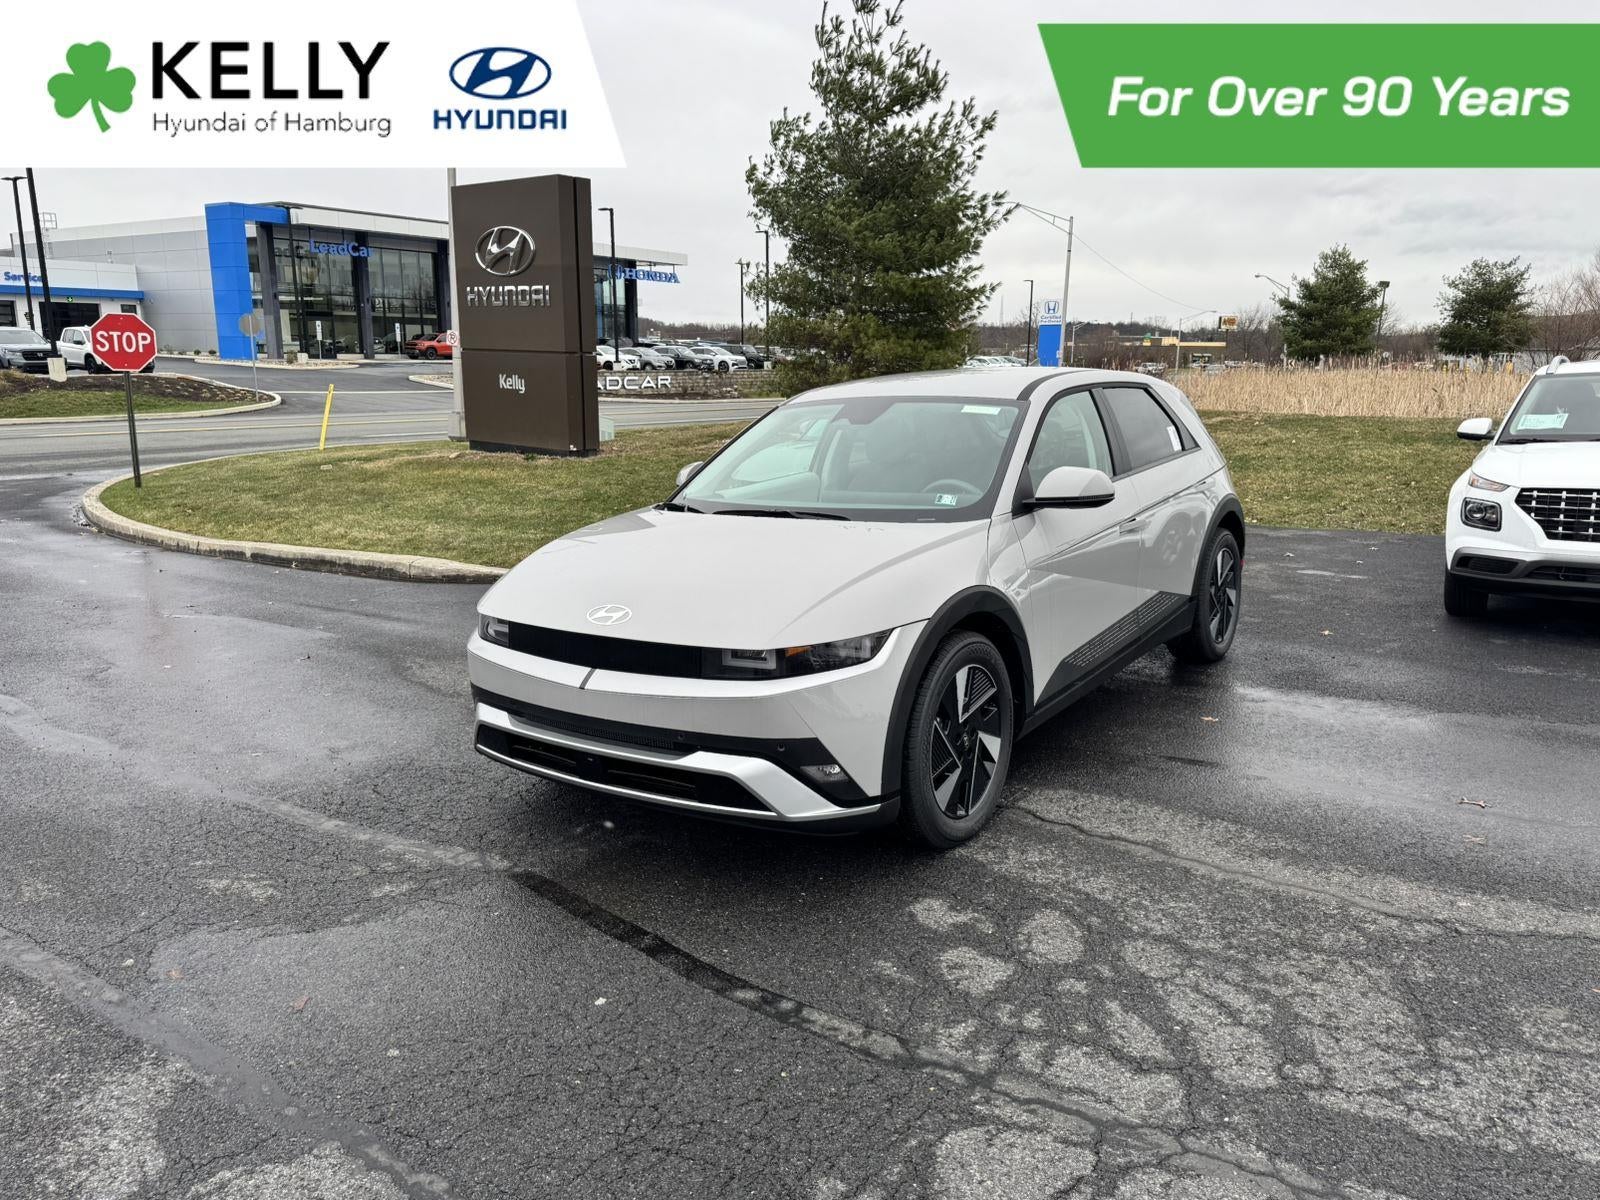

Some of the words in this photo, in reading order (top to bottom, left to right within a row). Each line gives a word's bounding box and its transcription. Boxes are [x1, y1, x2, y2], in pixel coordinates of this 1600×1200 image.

[309, 240, 373, 257] LeadCar
[4, 271, 46, 281] Seric
[466, 284, 551, 307] HYUNDAI
[95, 330, 151, 353] STOP
[499, 374, 526, 394] Kelly
